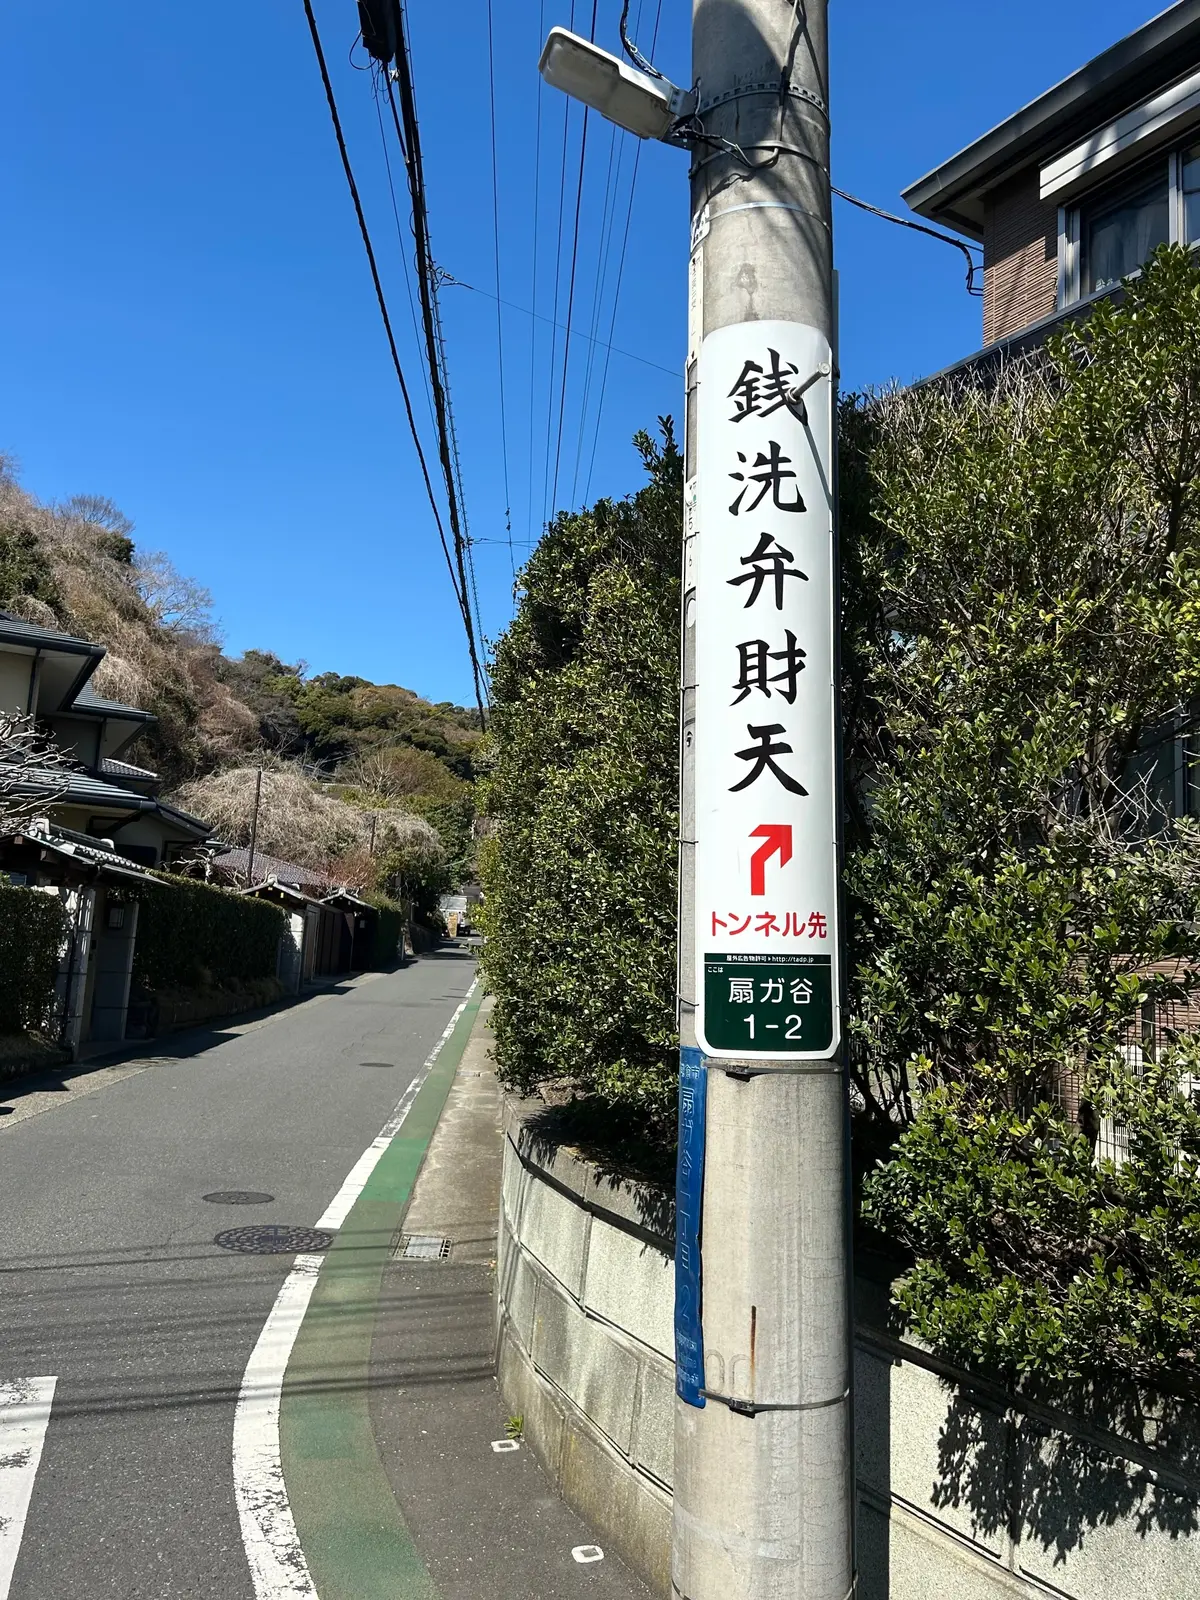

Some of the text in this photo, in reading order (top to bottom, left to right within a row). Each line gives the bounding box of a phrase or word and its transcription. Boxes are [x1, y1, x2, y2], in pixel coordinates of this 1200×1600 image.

[726, 347, 809, 797] 銭洗弁財天
[711, 911, 828, 939] トンネル先
[707, 966, 724, 974] ここは
[728, 977, 813, 1005] 扇ガ谷
[743, 1013, 802, 1040] 1-2
